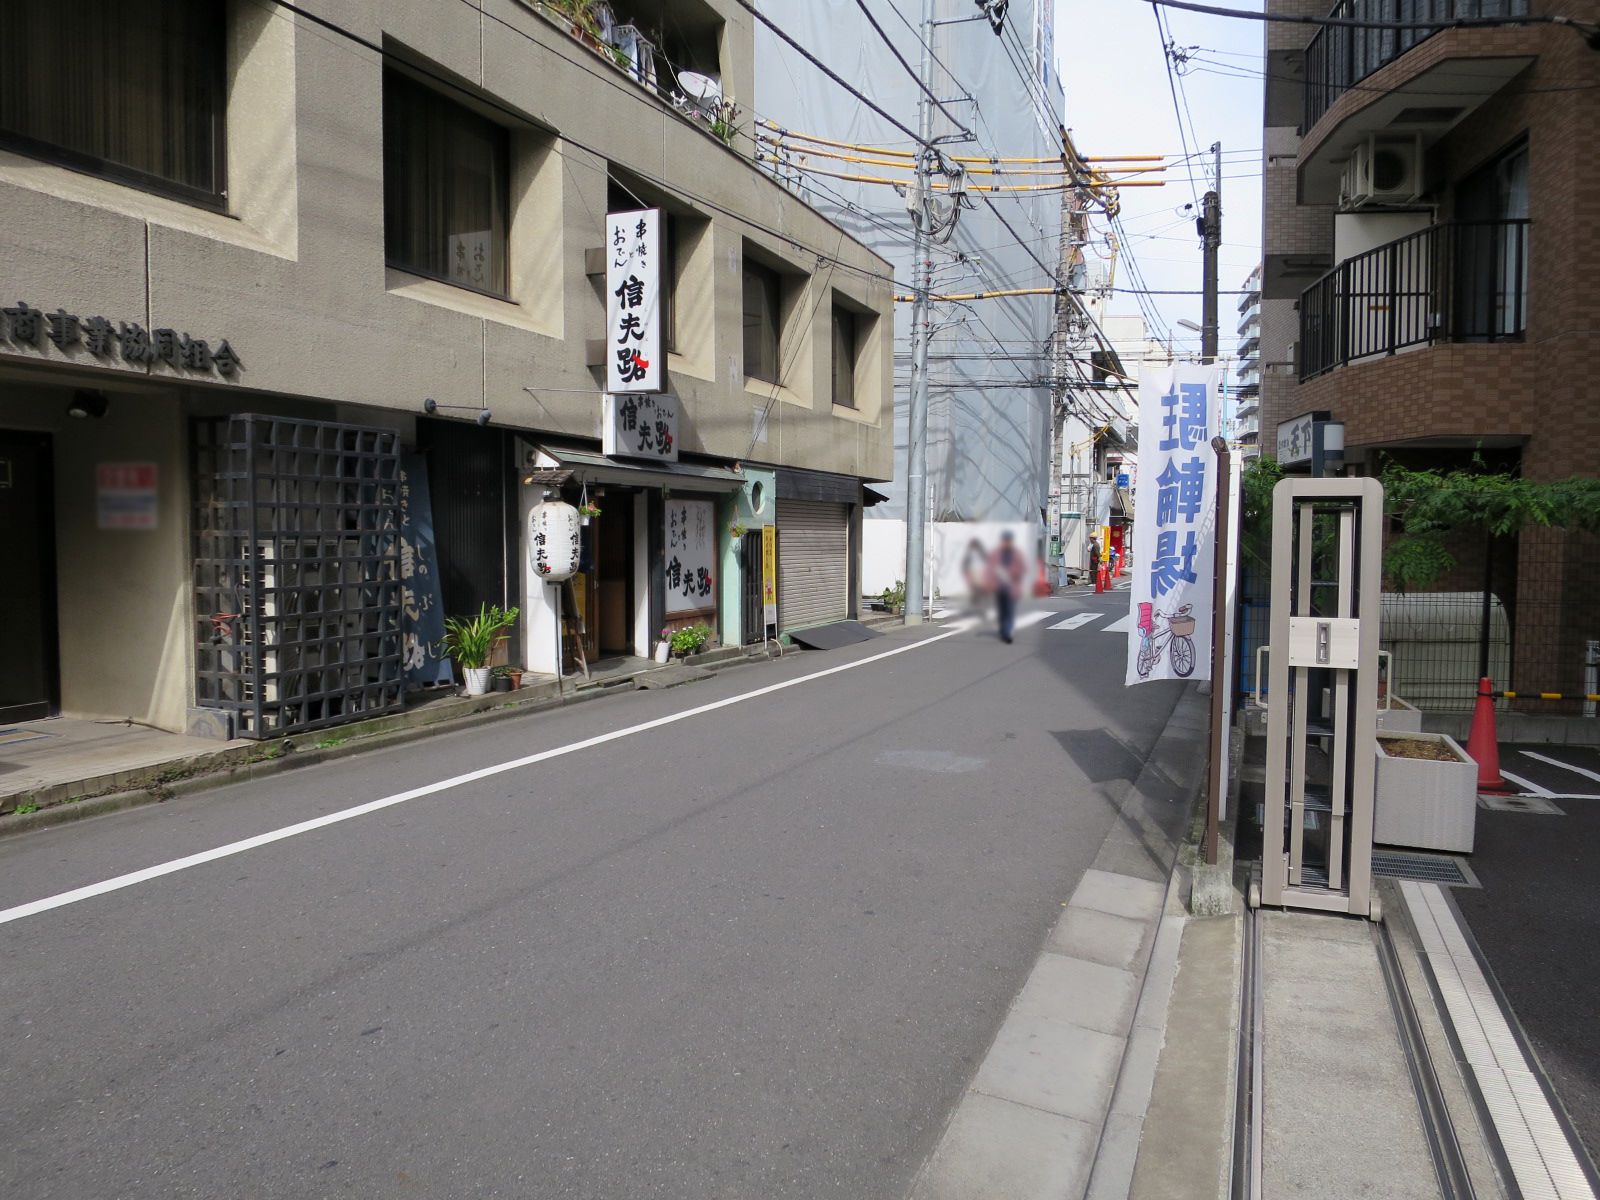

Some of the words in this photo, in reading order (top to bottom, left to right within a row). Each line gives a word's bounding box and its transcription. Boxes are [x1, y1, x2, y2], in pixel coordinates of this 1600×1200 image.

[613, 225, 628, 268] おでん
[614, 274, 649, 383] 信夫路
[665, 555, 712, 598] 信夫路
